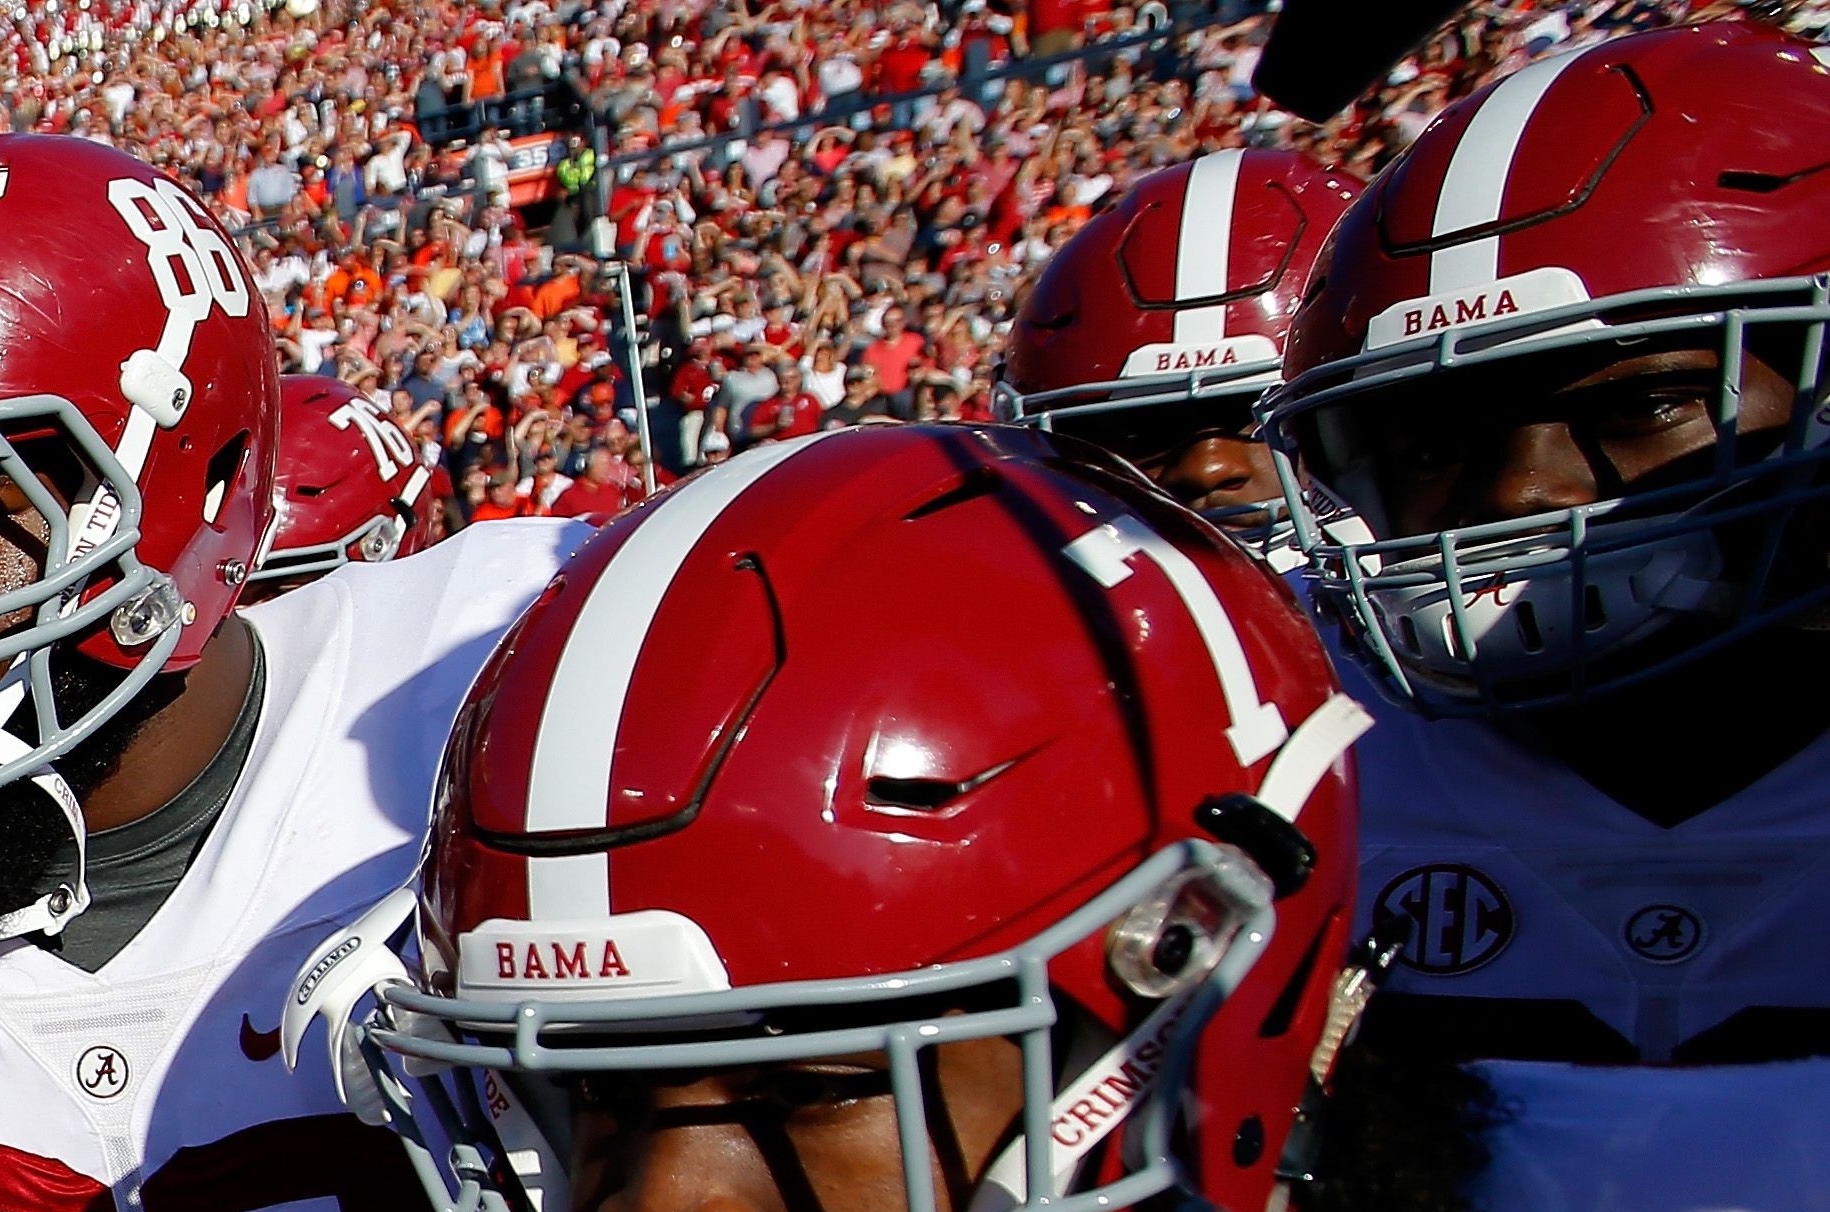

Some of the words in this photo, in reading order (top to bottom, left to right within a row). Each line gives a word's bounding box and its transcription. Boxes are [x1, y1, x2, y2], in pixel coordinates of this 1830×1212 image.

[108, 177, 250, 320] 86
[1403, 289, 1520, 337] BAMA
[1154, 344, 1239, 372] BAMA
[328, 398, 414, 482] 76
[1062, 513, 1289, 768] 7
[1381, 870, 1504, 967] SEC
[1634, 910, 1685, 950] A
[496, 938, 631, 979] BAMA
[84, 1052, 124, 1091] A
